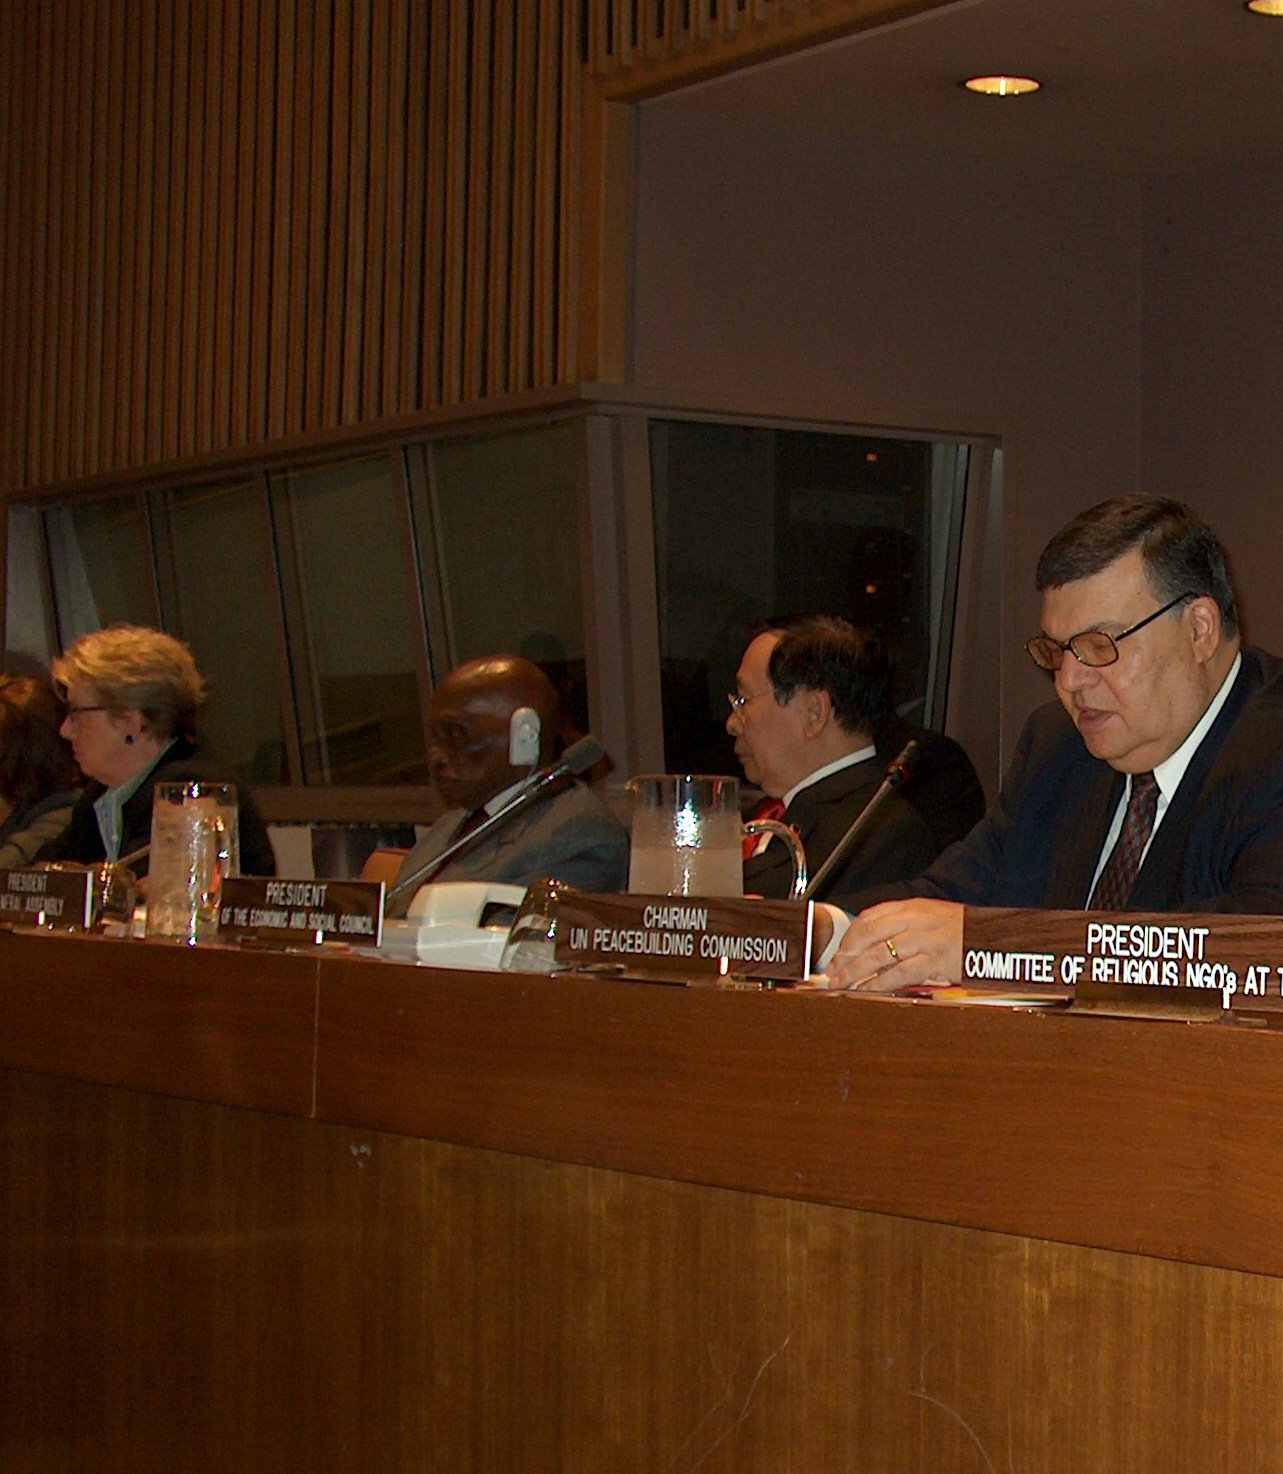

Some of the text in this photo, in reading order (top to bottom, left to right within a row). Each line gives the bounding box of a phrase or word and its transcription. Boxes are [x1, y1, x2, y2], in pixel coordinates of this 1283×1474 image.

[266, 881, 328, 908] PRESIDENT
[221, 906, 375, 935] OF THE ECONOMIC AND SOCIAL COUNCIL
[643, 905, 708, 931] CHAIRMAN
[570, 927, 788, 963] UN PEACEBUILDING COMMISSION
[1087, 922, 1210, 961] PRESIDENT
[964, 949, 1056, 983] COMMITTEE
[1060, 955, 1087, 985] OF
[1091, 956, 1179, 987] RELIGIOUS
[1243, 965, 1271, 997] AT
